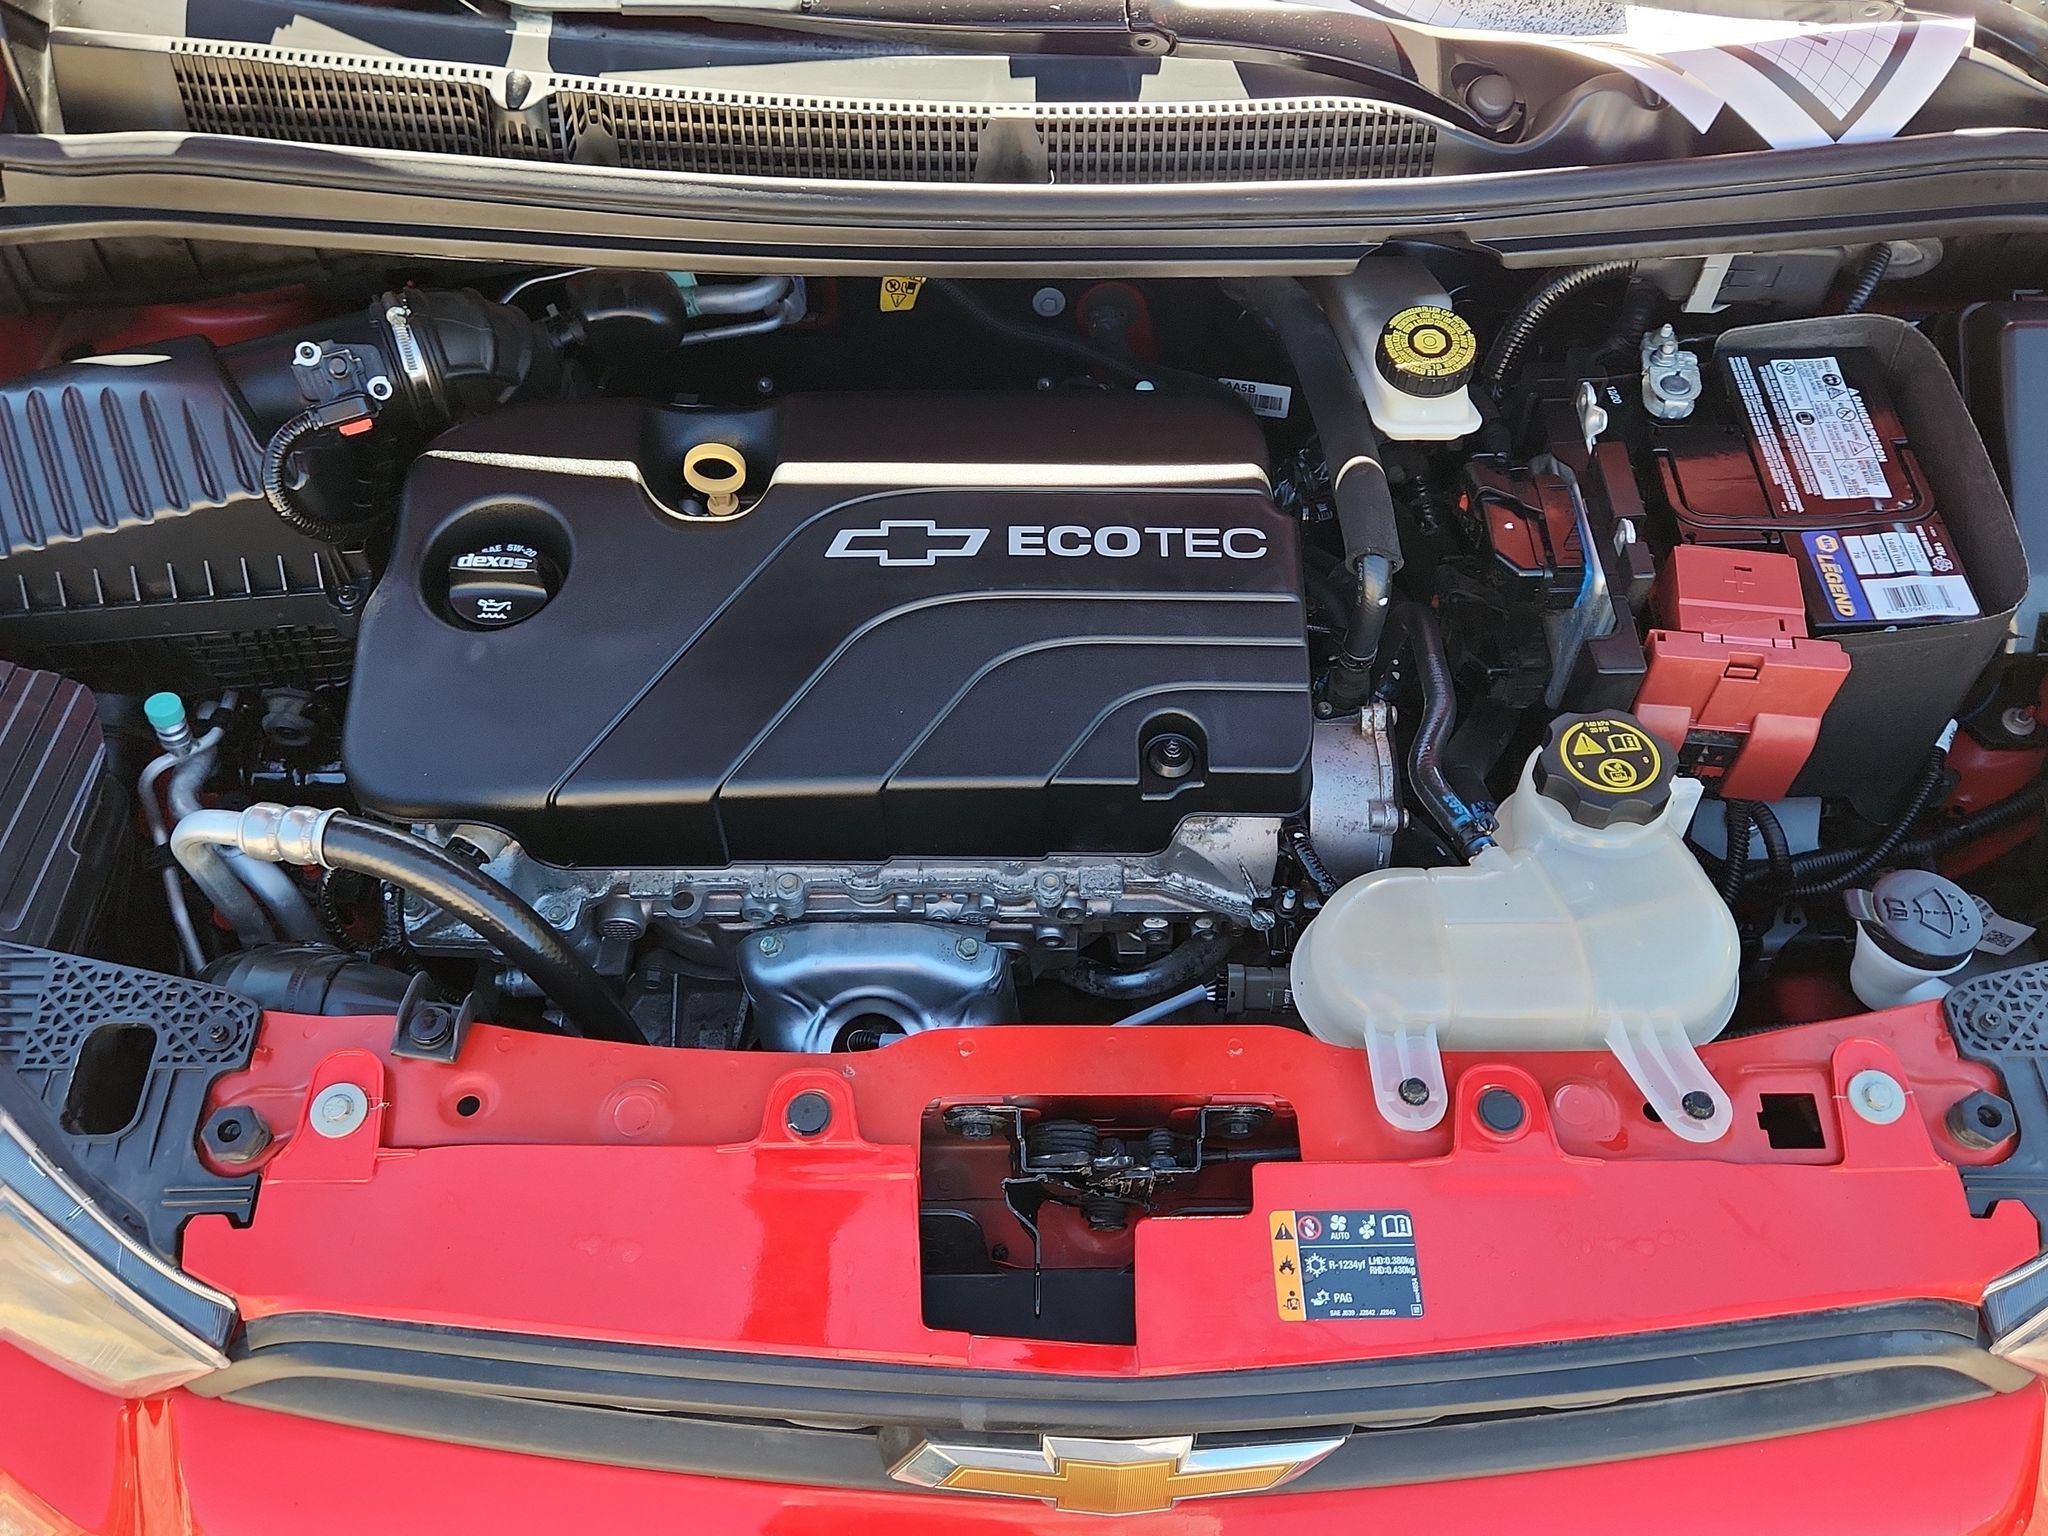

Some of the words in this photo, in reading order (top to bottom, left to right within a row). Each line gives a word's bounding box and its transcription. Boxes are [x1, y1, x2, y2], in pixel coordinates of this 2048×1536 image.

[1606, 386, 1622, 404] 12/20
[1853, 396, 1888, 462] DANGER/POISON
[1008, 525, 1267, 558] ECOTEC
[506, 543, 537, 558] 5W-20
[457, 553, 533, 569] dexos
[1816, 554, 1857, 617] LEGEND
[1330, 1231, 1350, 1240] AUTO
[1328, 1260, 1366, 1271] R-1234yf
[1334, 1292, 1353, 1303] PAG
